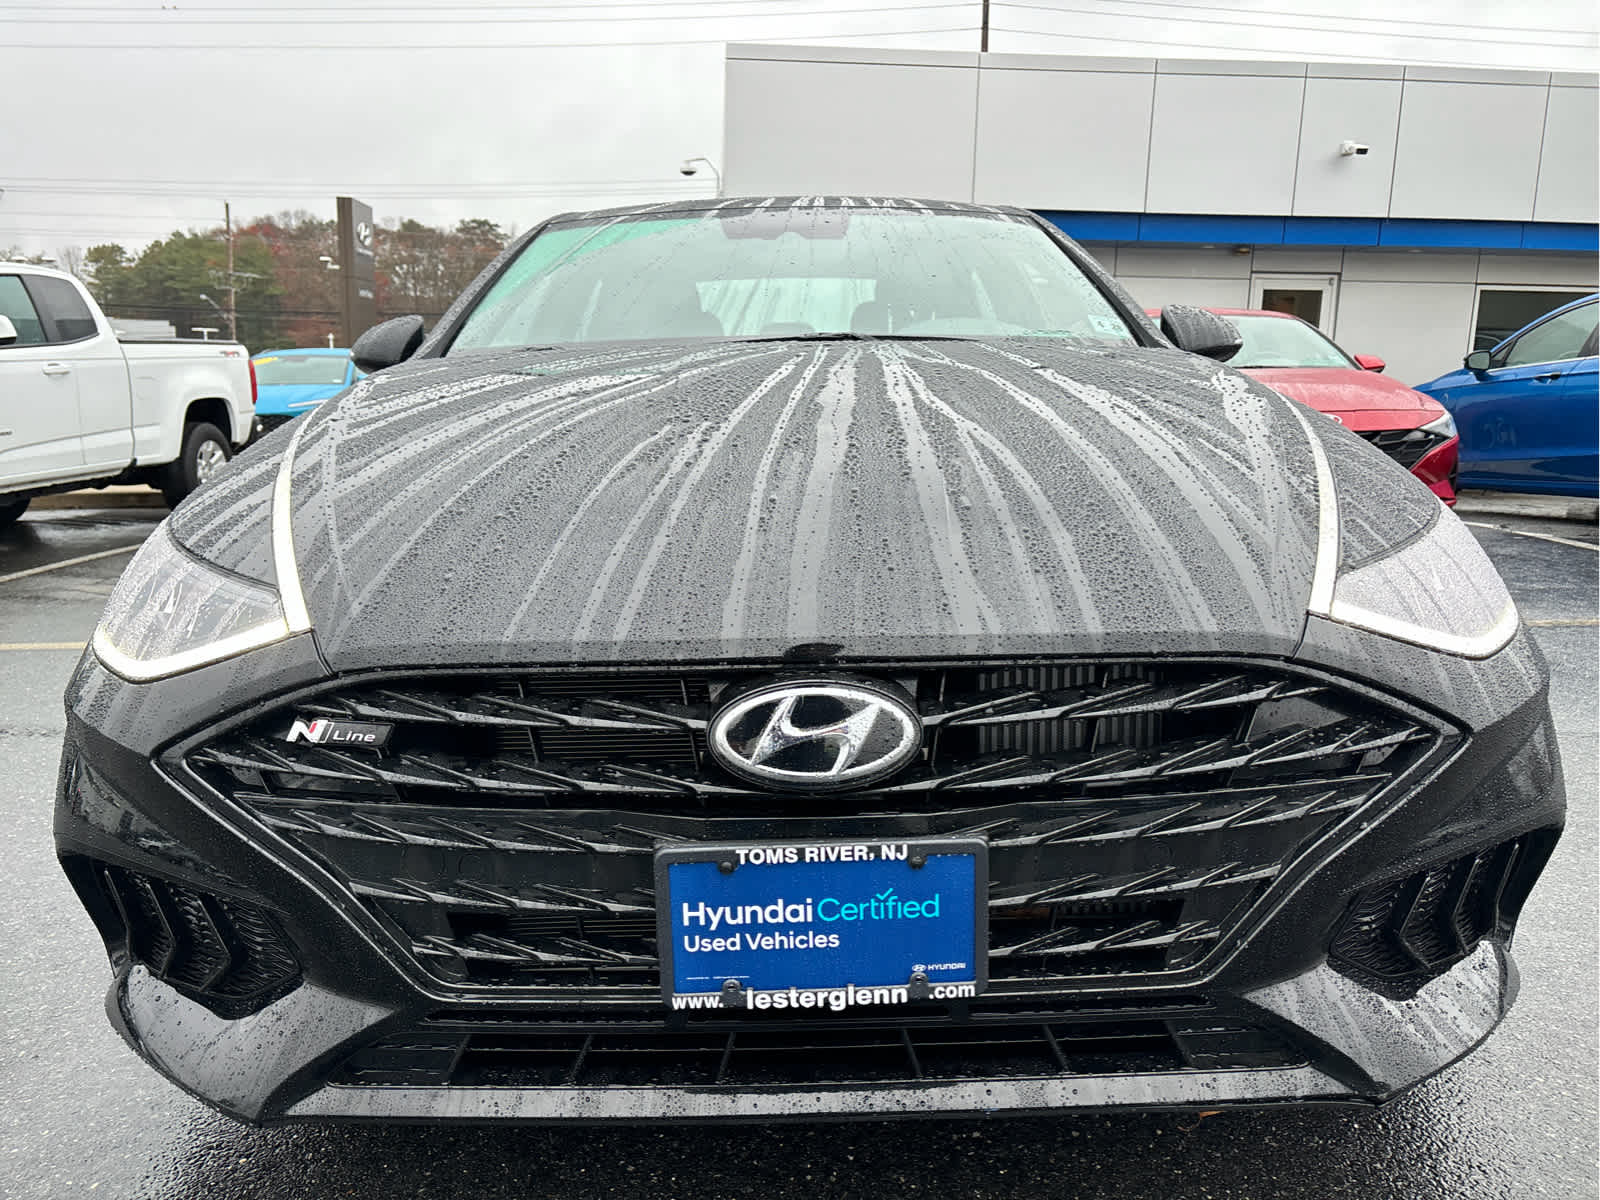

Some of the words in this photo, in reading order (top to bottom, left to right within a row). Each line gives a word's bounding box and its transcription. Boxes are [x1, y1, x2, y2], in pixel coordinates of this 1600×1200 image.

[332, 729, 376, 742] Line
[736, 848, 798, 865] TOMS
[804, 845, 874, 863] RIVER,
[881, 843, 908, 861] NJ
[682, 898, 813, 930] Hyundai
[817, 887, 940, 922] Certified
[684, 933, 741, 952] Used
[745, 931, 840, 950] Vehicles
[927, 962, 966, 970] HYUNDAI
[671, 995, 724, 1010] www.
[746, 985, 908, 1011] lesterglenn
[928, 984, 976, 1000] .com
